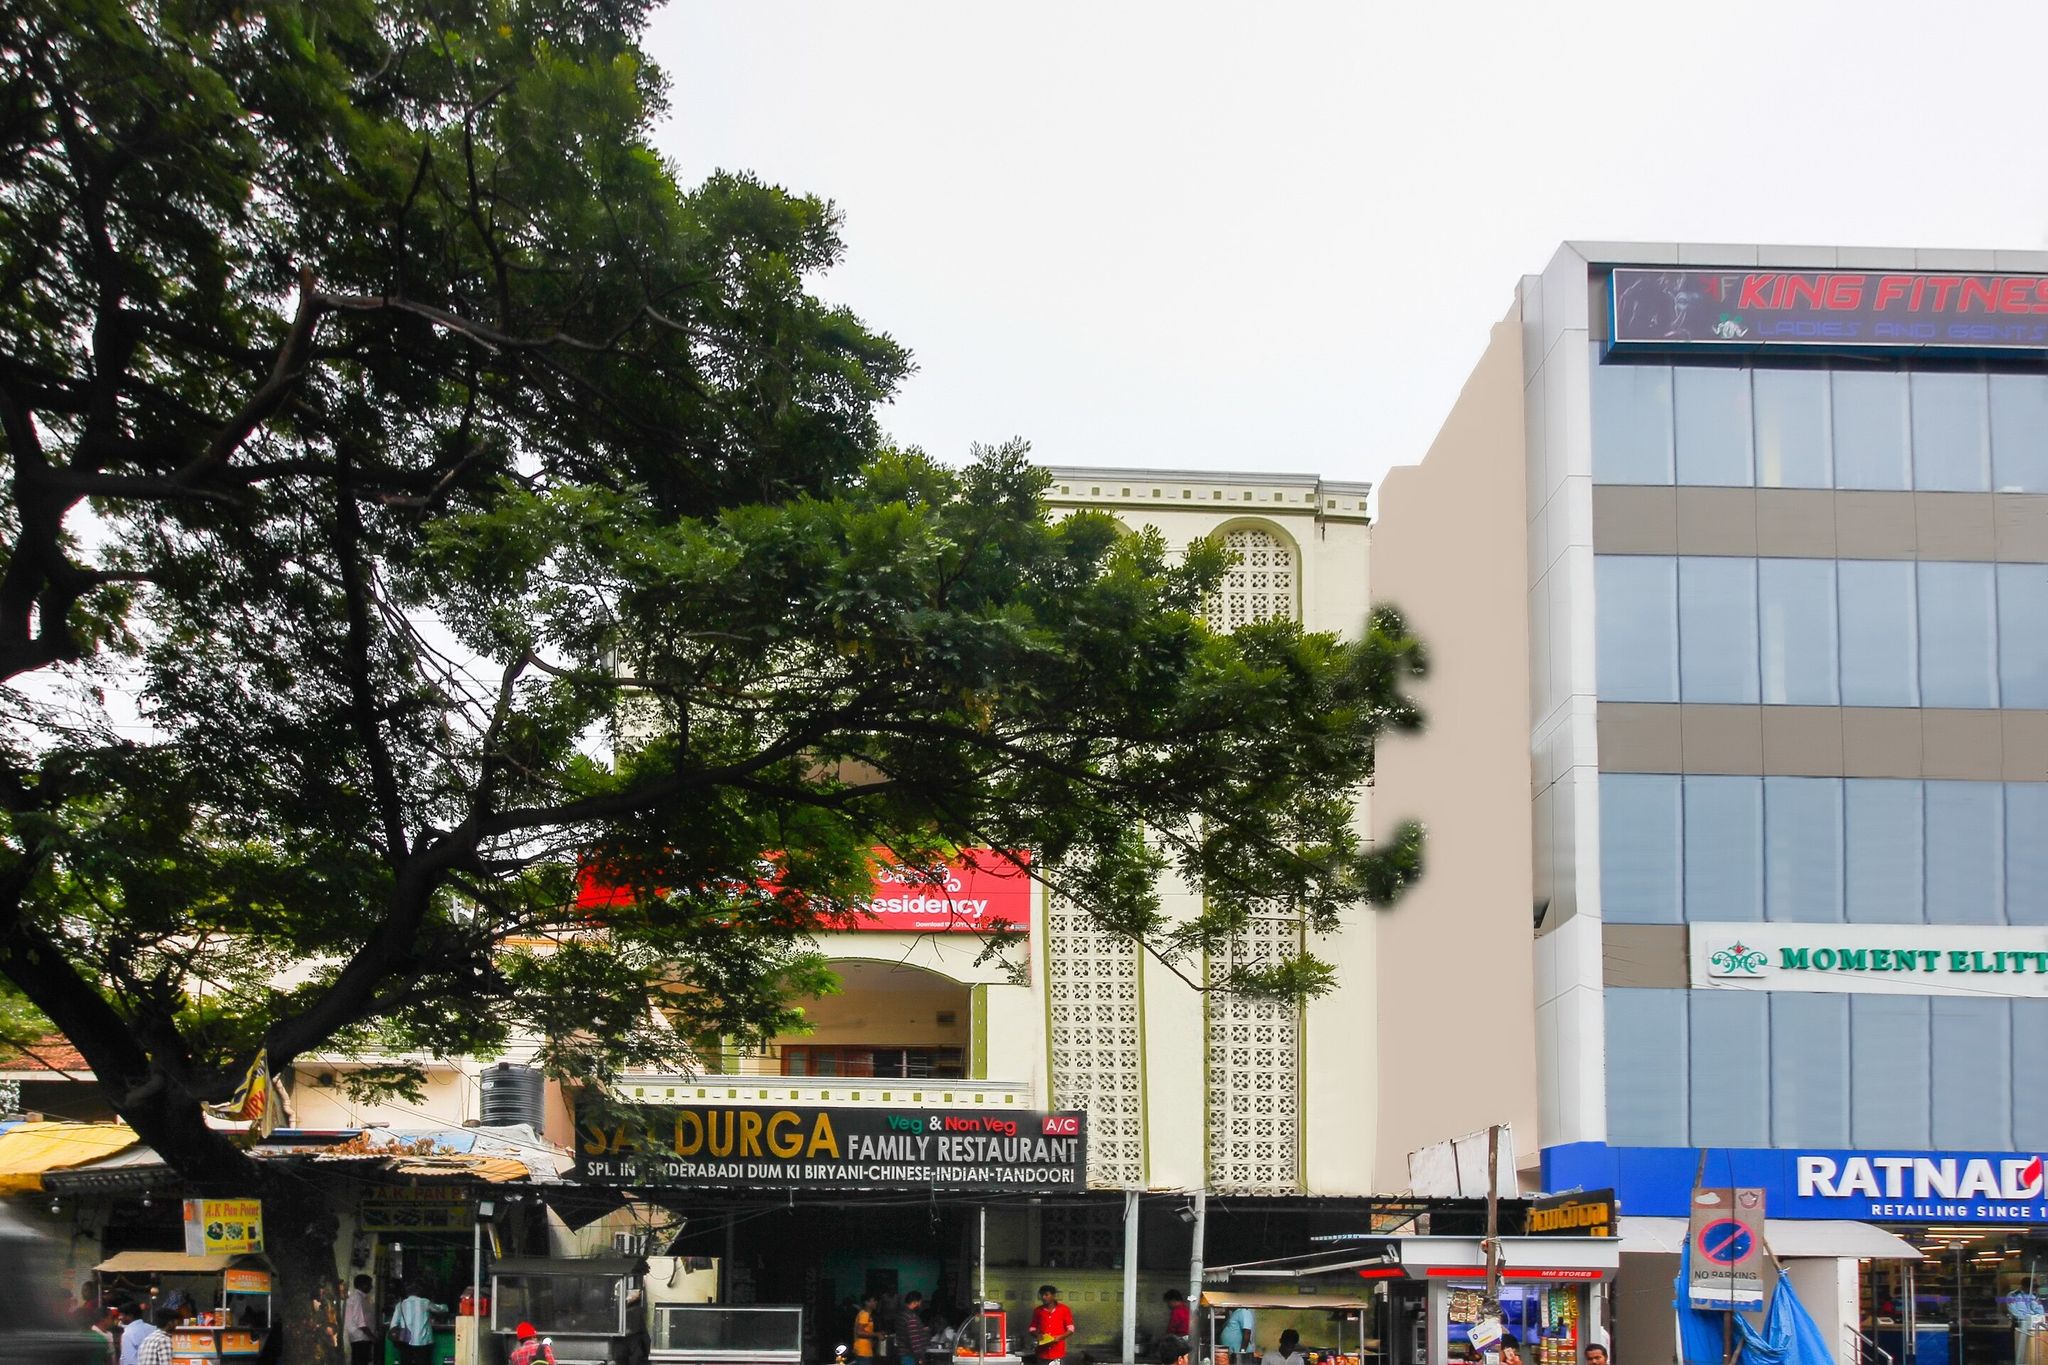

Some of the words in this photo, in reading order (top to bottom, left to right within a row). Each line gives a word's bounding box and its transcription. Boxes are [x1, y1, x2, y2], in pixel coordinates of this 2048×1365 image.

[1737, 274, 1866, 311] KING
[1758, 320, 1861, 338] LADIES
[1874, 322, 1937, 339] AND
[1778, 947, 1941, 972] MOMENT
[673, 1110, 840, 1159] DURGA
[887, 1114, 924, 1134] Veg
[929, 1115, 942, 1131] &
[945, 1116, 980, 1131] Non
[983, 1117, 1017, 1136] Veg
[1045, 1118, 1076, 1132] A/C
[848, 1135, 930, 1161] FAMILY
[937, 1136, 1078, 1163] RESTAURANT
[588, 1161, 615, 1177] SPL.
[748, 1164, 782, 1179] DUM
[786, 1165, 800, 1179] KI
[1797, 1155, 2048, 1200] RATNAD
[1872, 1203, 1967, 1217] RETAILING
[1977, 1205, 2031, 1218] SINCE
[1694, 1270, 1710, 1280] NO
[1711, 1272, 1757, 1281] PARKING
